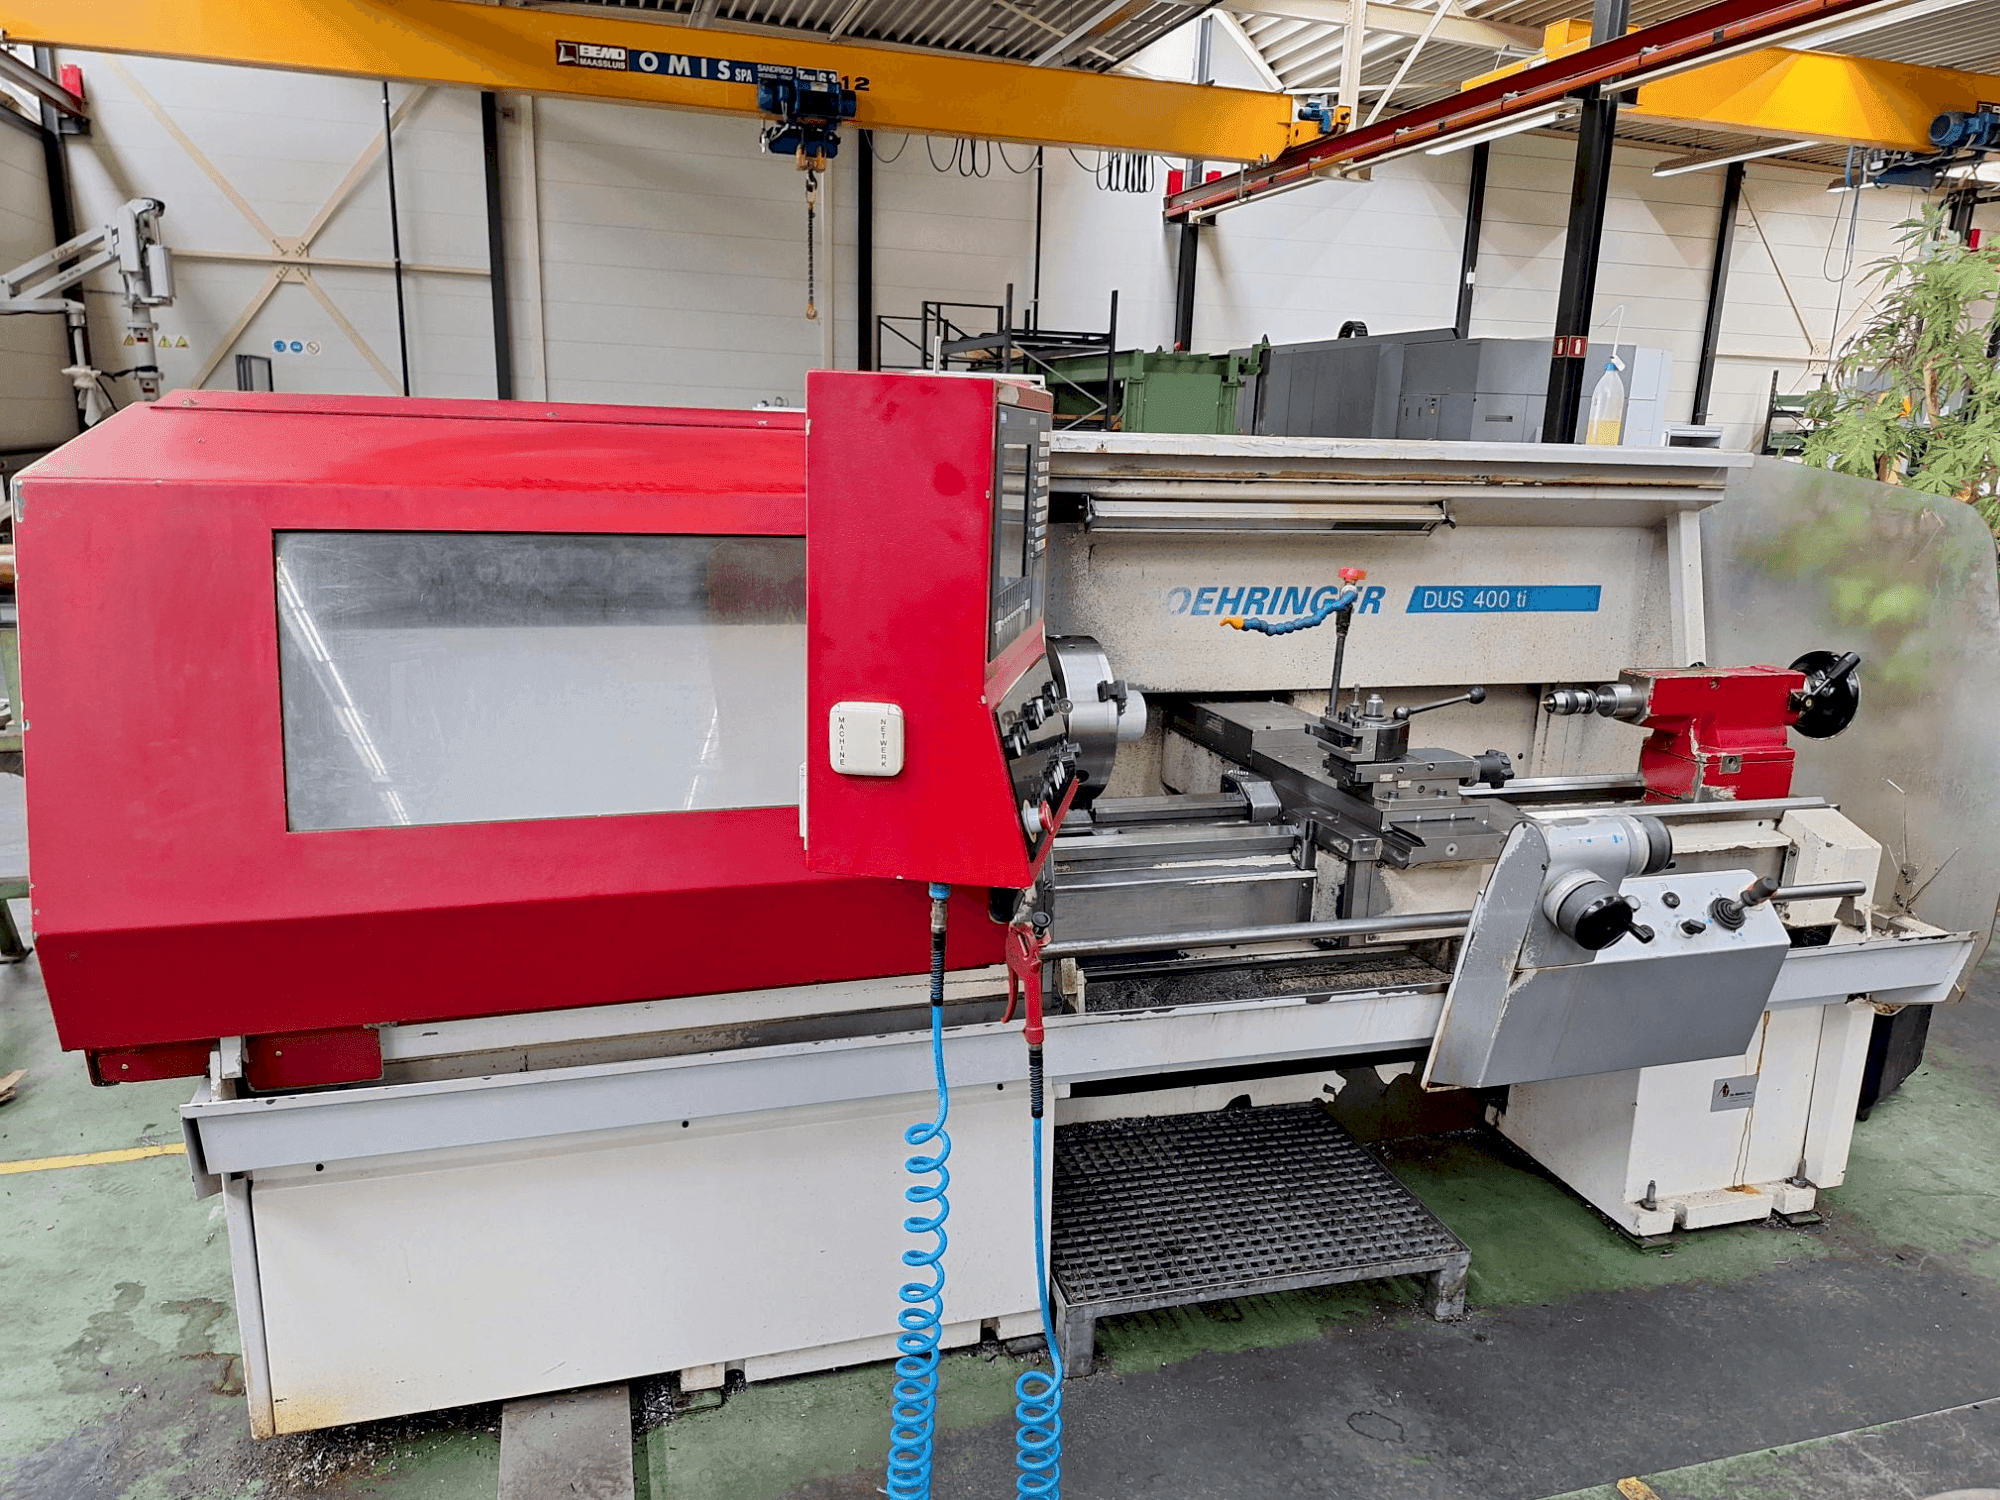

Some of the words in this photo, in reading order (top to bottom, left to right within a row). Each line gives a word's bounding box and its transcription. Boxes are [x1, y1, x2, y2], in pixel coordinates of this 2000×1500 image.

[580, 57, 626, 70] MAASSLUIS
[757, 64, 793, 75] SANDRIGO
[735, 68, 753, 82] SPA
[841, 76, 871, 92] 12
[1423, 590, 1464, 609] DUS
[1473, 590, 1510, 609] 400
[1516, 589, 1528, 608] ti
[879, 718, 888, 768] NETWERK
